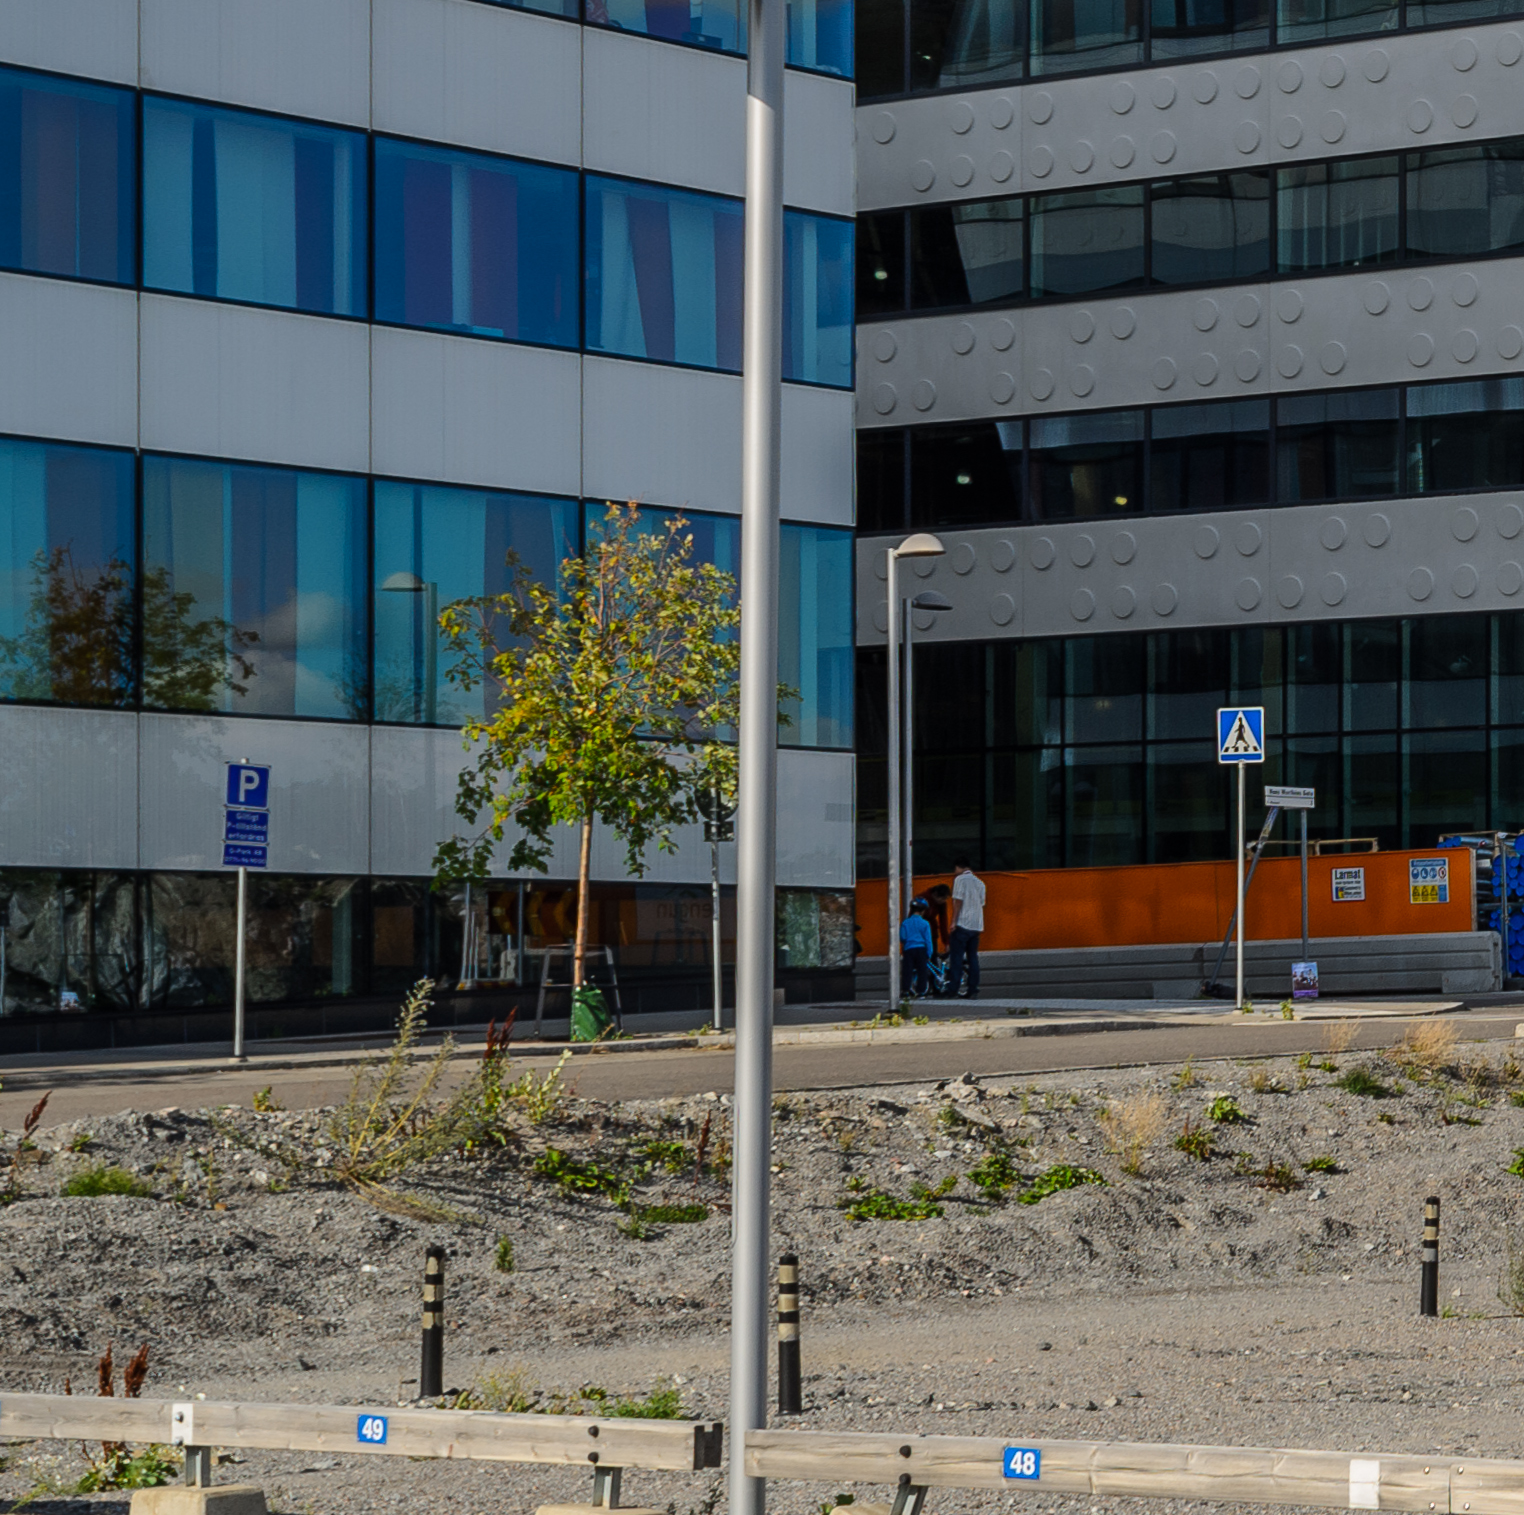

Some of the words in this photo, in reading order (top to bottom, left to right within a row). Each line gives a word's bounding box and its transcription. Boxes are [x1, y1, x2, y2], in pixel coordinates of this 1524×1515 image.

[239, 769, 259, 802] P
[362, 1417, 384, 1440] 49
[1010, 1451, 1036, 1476] 48
